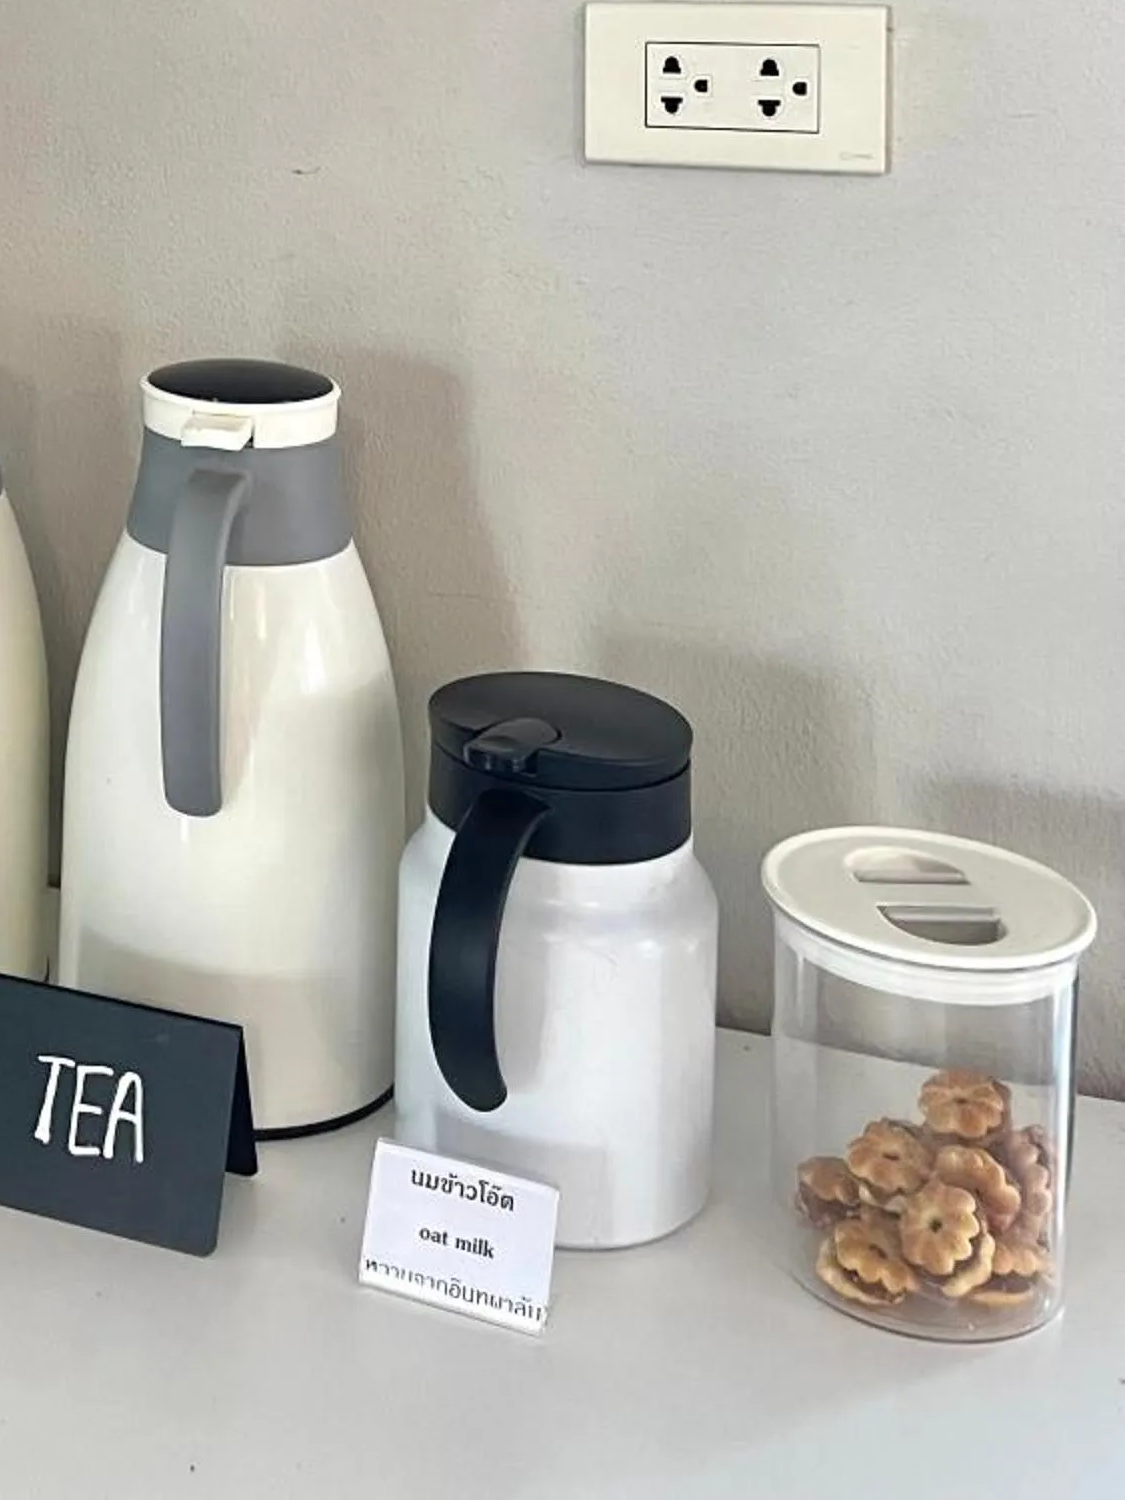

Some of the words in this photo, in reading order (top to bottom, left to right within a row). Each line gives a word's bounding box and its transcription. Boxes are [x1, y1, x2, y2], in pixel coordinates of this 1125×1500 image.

[34, 1054, 145, 1165] TEA
[418, 1227, 449, 1247] oat
[455, 1236, 495, 1260] milk
